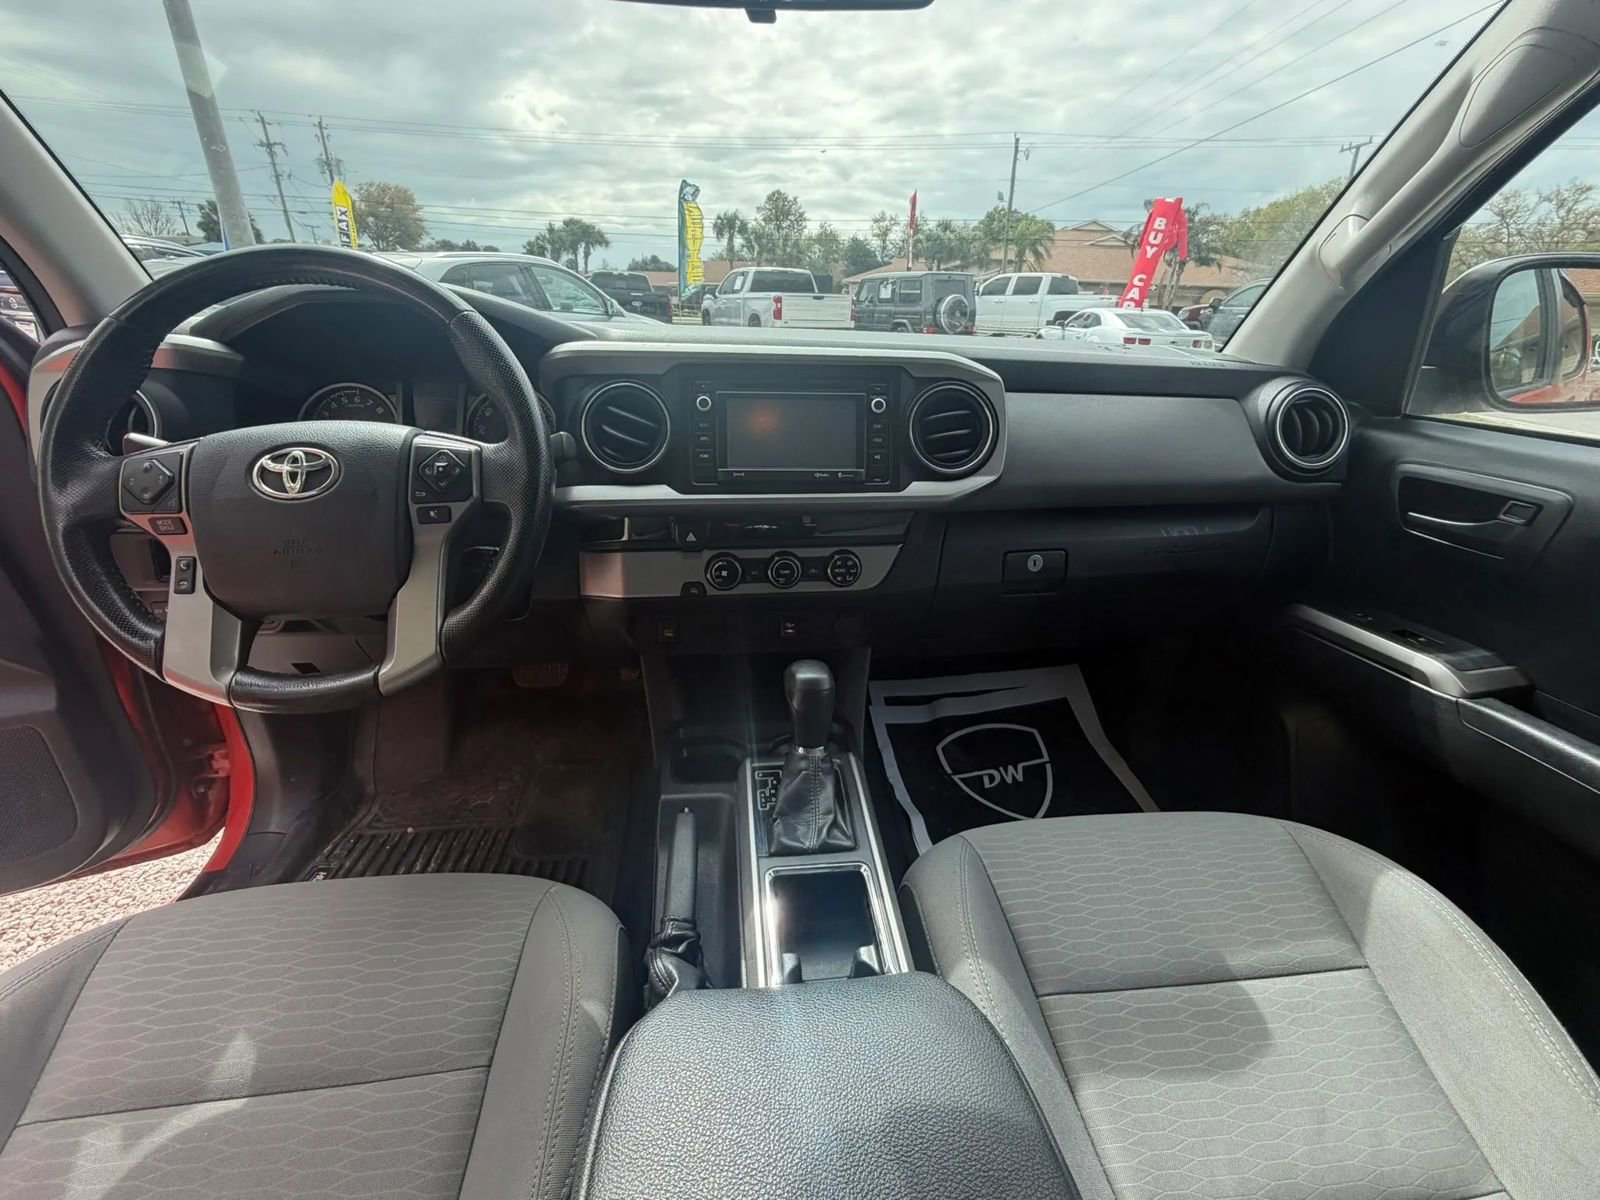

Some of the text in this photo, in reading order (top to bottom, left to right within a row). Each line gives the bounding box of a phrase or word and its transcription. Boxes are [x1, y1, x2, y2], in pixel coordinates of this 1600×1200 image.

[1145, 217, 1167, 258] BUY
[341, 397, 349, 405] 5
[353, 395, 361, 404] 6
[366, 398, 375, 407] 7
[982, 765, 1024, 789] DW
